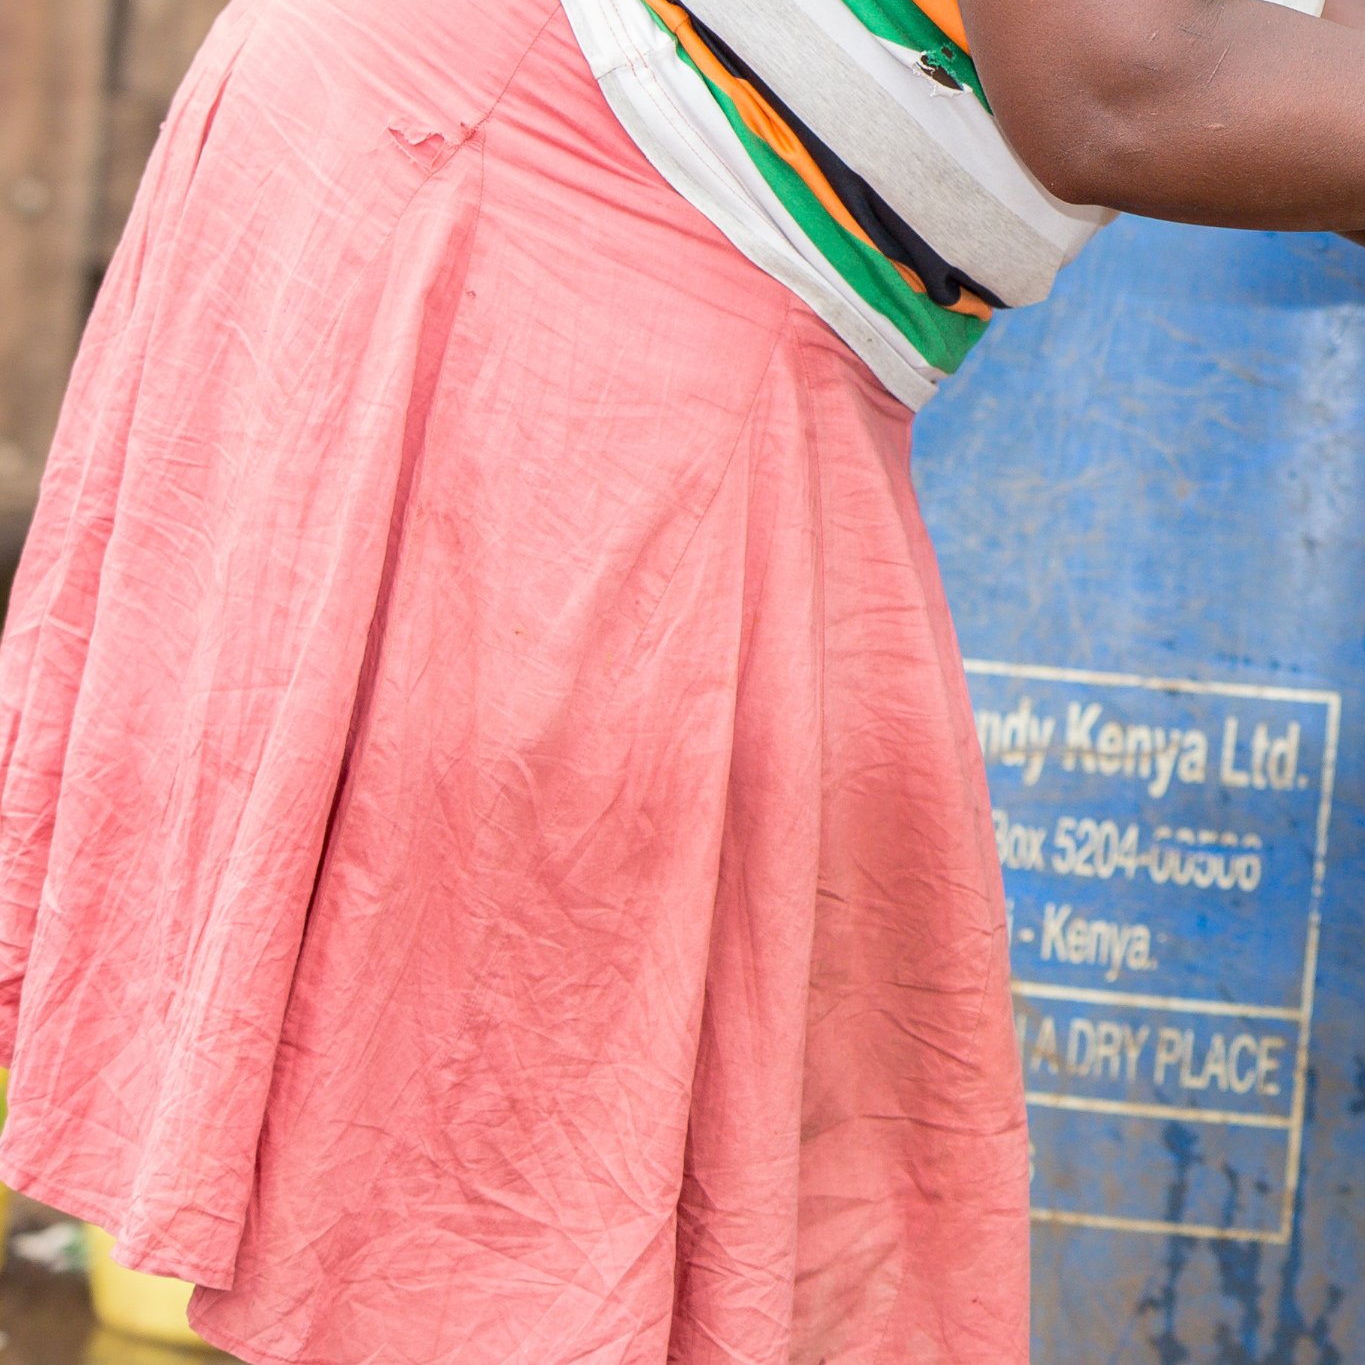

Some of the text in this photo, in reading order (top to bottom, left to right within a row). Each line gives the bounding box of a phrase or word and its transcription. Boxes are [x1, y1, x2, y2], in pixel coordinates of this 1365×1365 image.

[975, 696, 1311, 799] ndy Kenya Ltd.
[1040, 901, 1158, 982] Kenya.
[1030, 1015, 1060, 1074] A
[1065, 1021, 1150, 1085] DRY
[1153, 1026, 1287, 1097] PLACE
